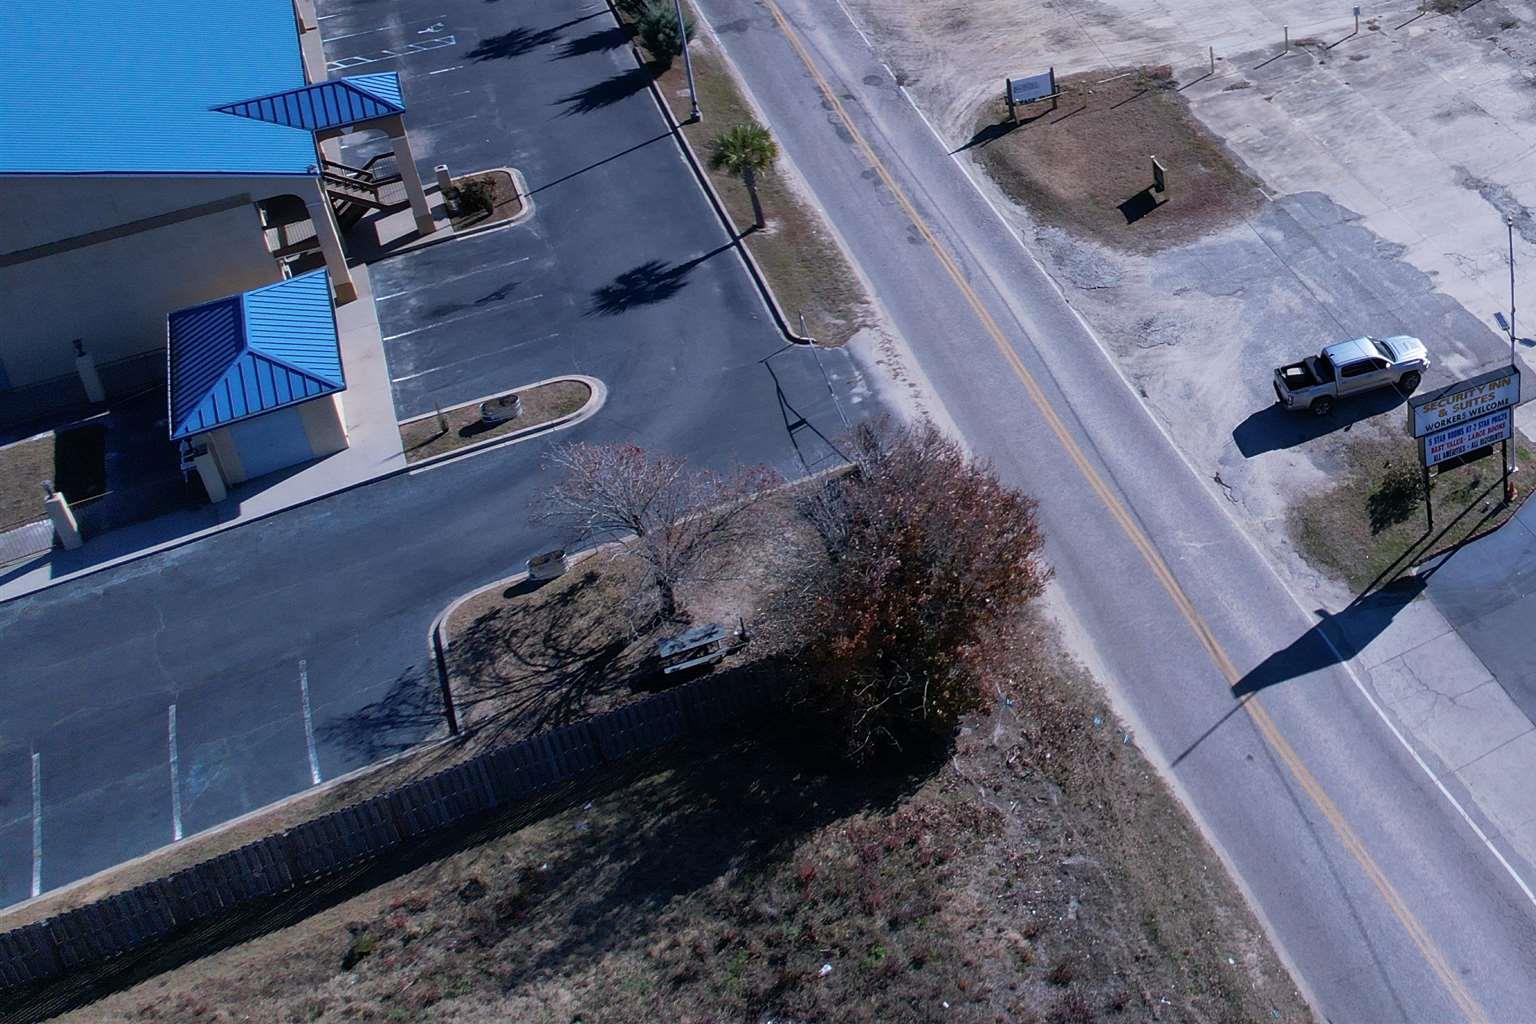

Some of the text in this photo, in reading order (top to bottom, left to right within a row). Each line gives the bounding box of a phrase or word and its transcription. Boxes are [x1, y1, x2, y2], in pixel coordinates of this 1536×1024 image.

[1424, 376, 1511, 413] SECURITY INN
[1439, 391, 1495, 417] & SUITES
[1425, 398, 1509, 432] WORKERS WELCOME
[1434, 434, 1445, 445] STAR
[1478, 418, 1490, 429] STAR
